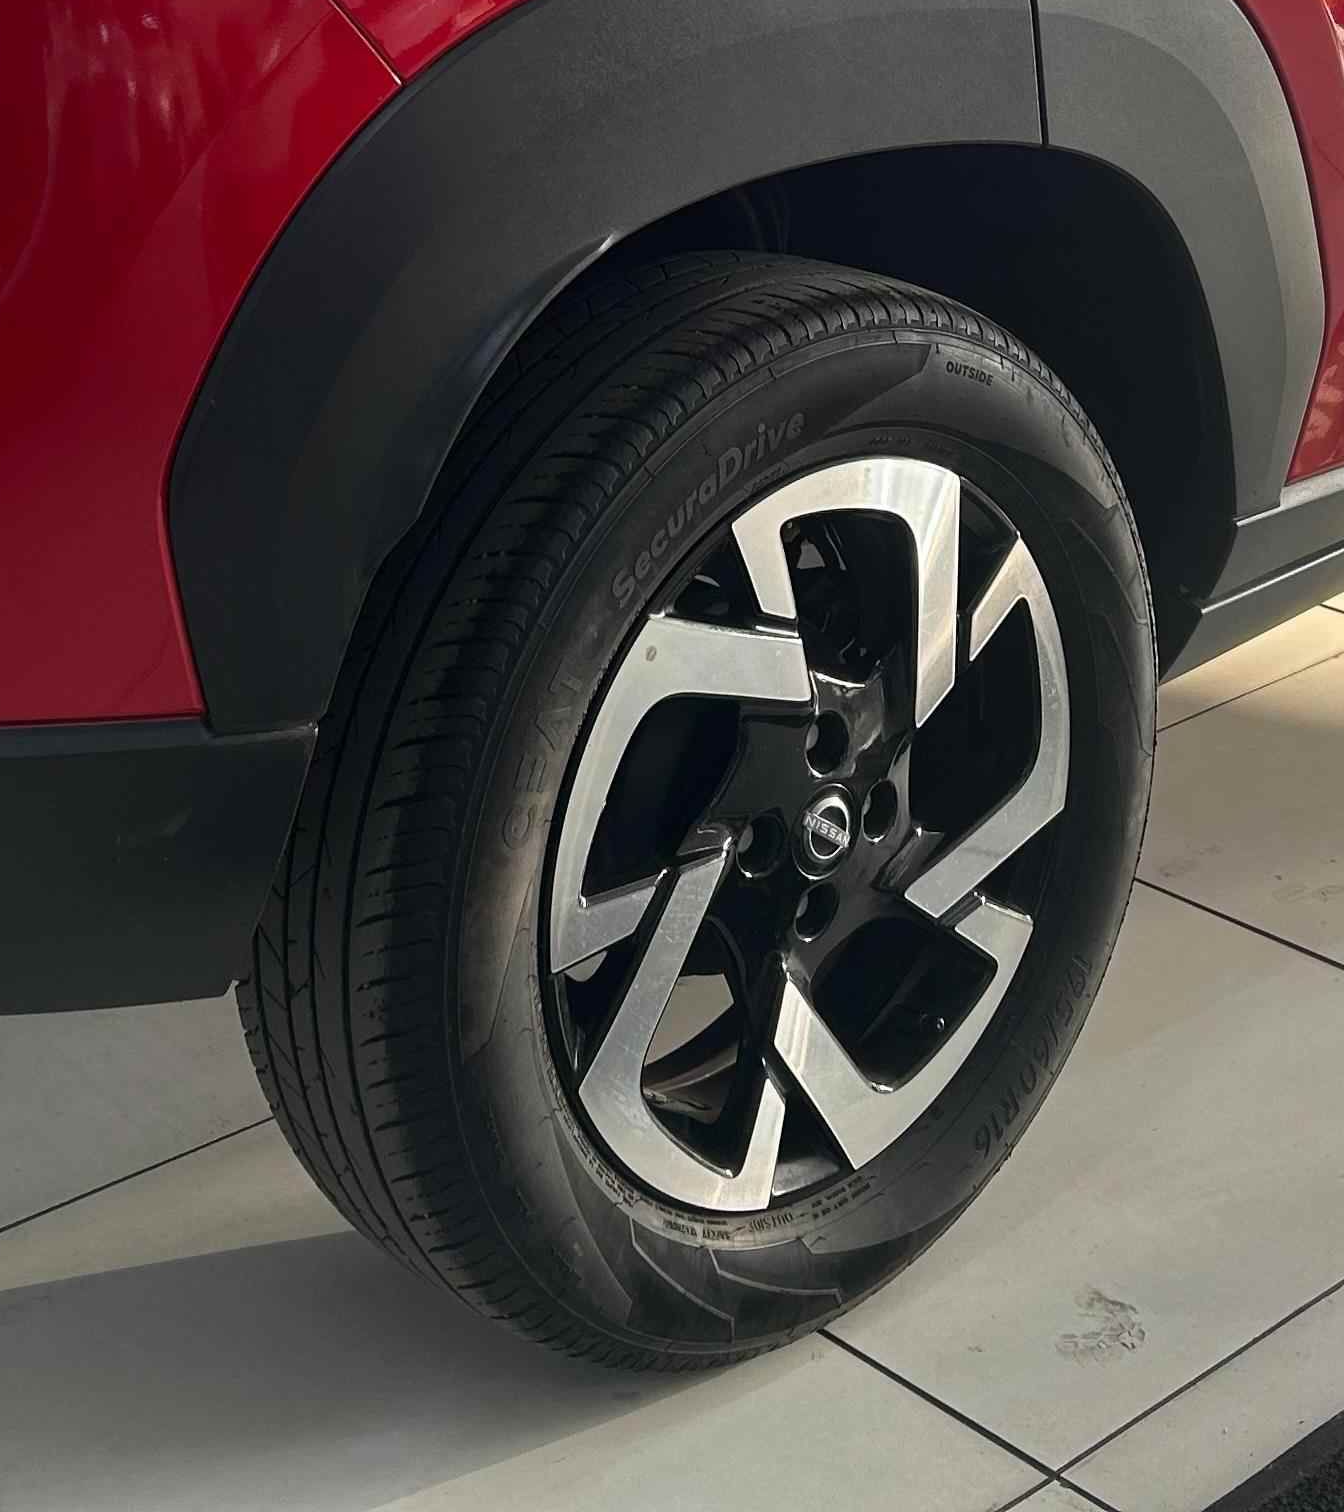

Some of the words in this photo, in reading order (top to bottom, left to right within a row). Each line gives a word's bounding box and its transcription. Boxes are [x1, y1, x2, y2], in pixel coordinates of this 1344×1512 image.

[945, 360, 994, 386] OUTSIDE
[611, 412, 805, 608] SecuraDrive
[805, 813, 850, 848] NISSAN
